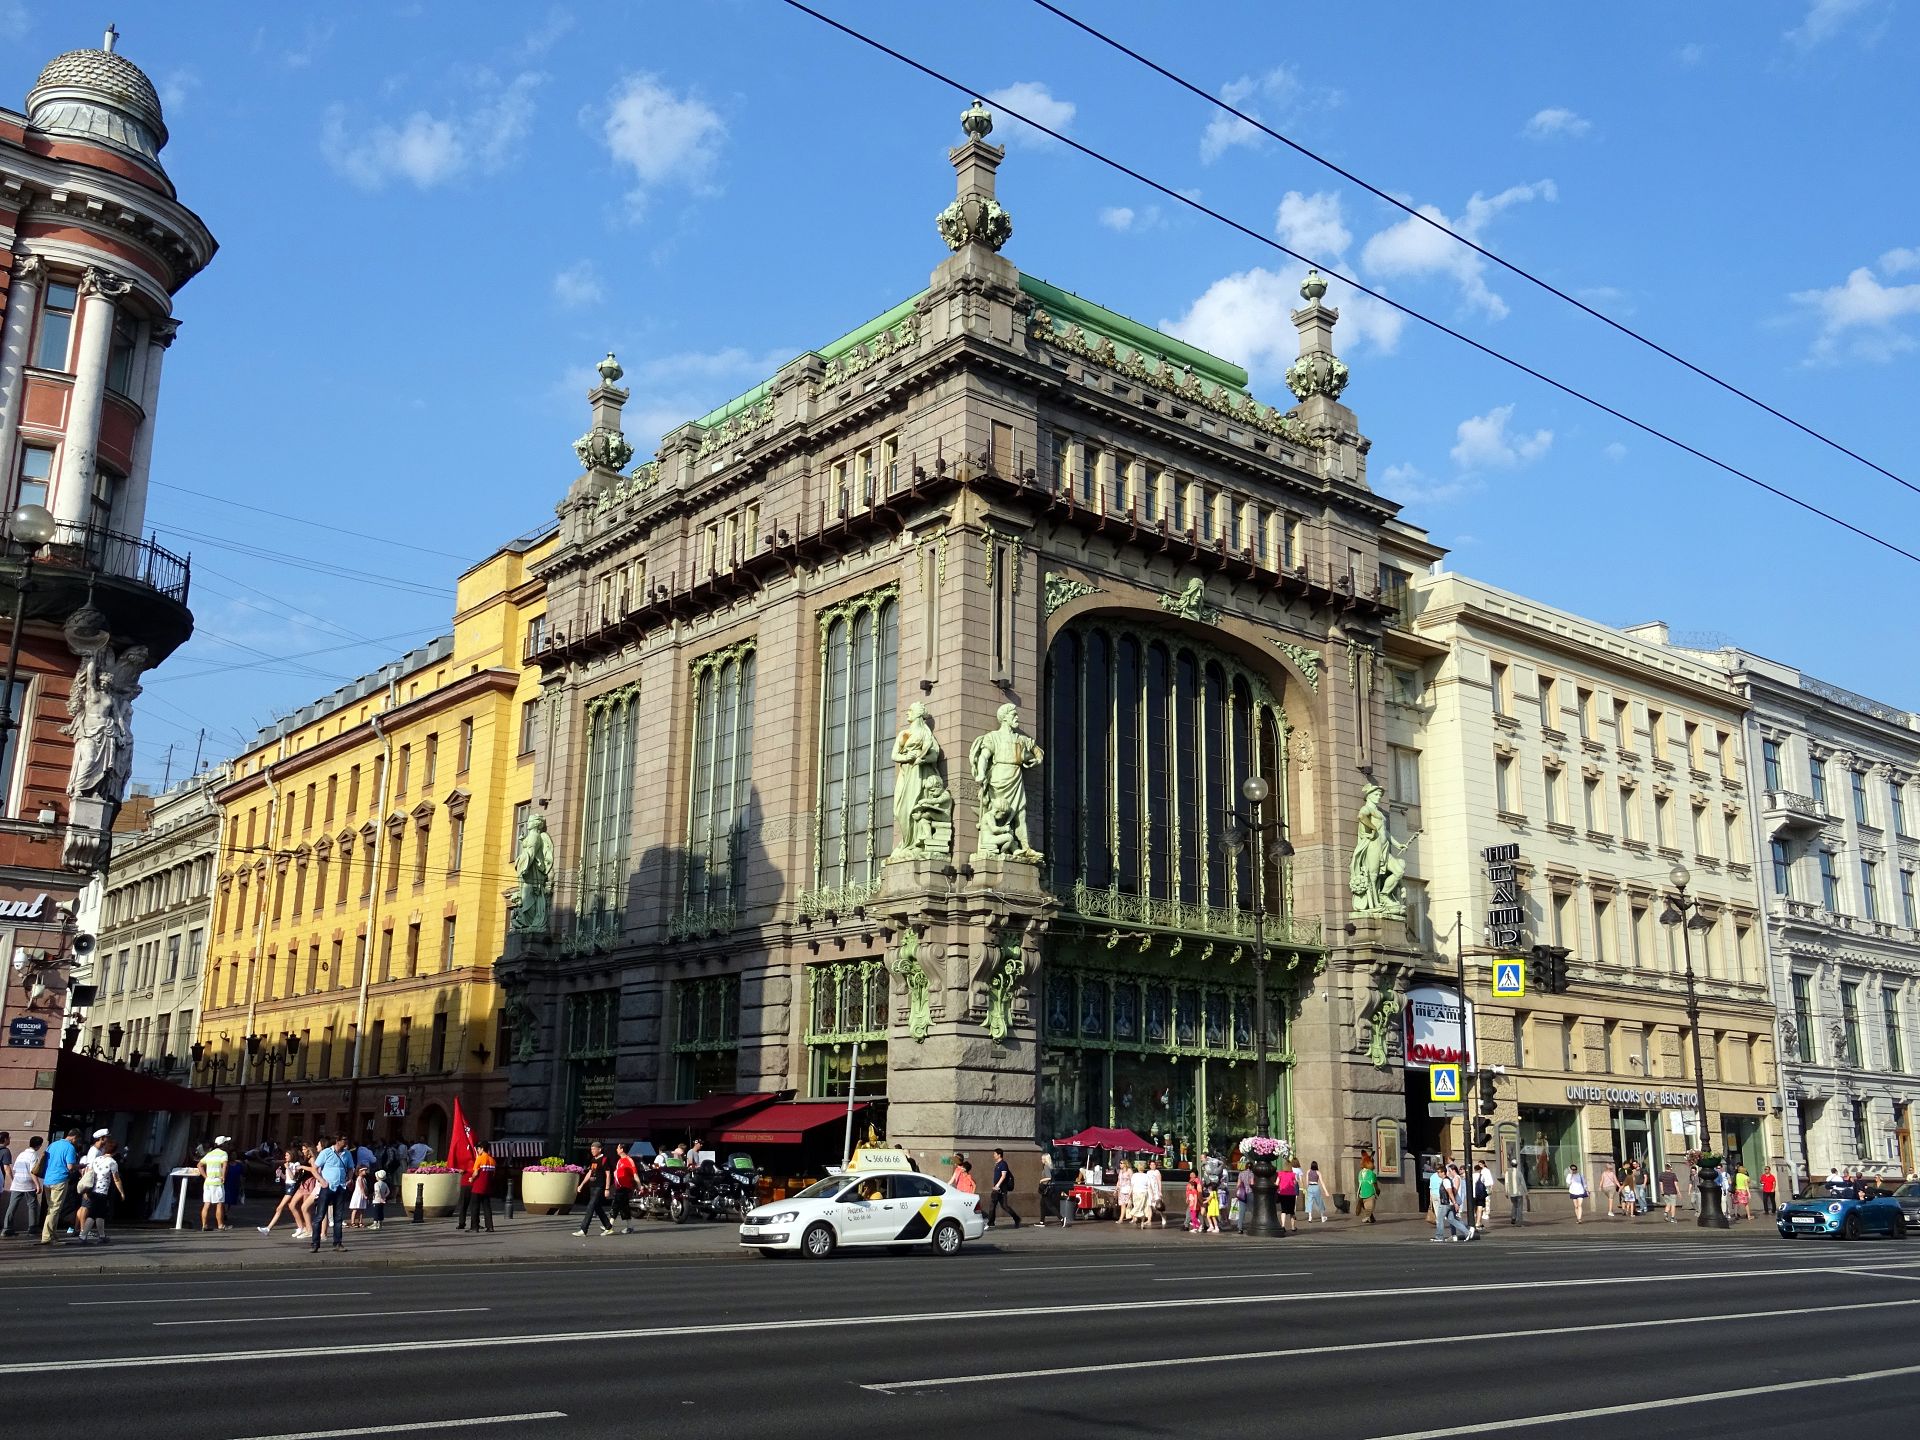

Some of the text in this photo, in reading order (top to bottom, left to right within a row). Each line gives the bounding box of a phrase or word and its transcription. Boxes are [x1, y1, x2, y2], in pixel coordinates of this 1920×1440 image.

[1566, 1086, 1699, 1107] UNITED COLORS OF BENETTO
[873, 1155, 883, 1163] 366
[884, 1155, 891, 1163] 66
